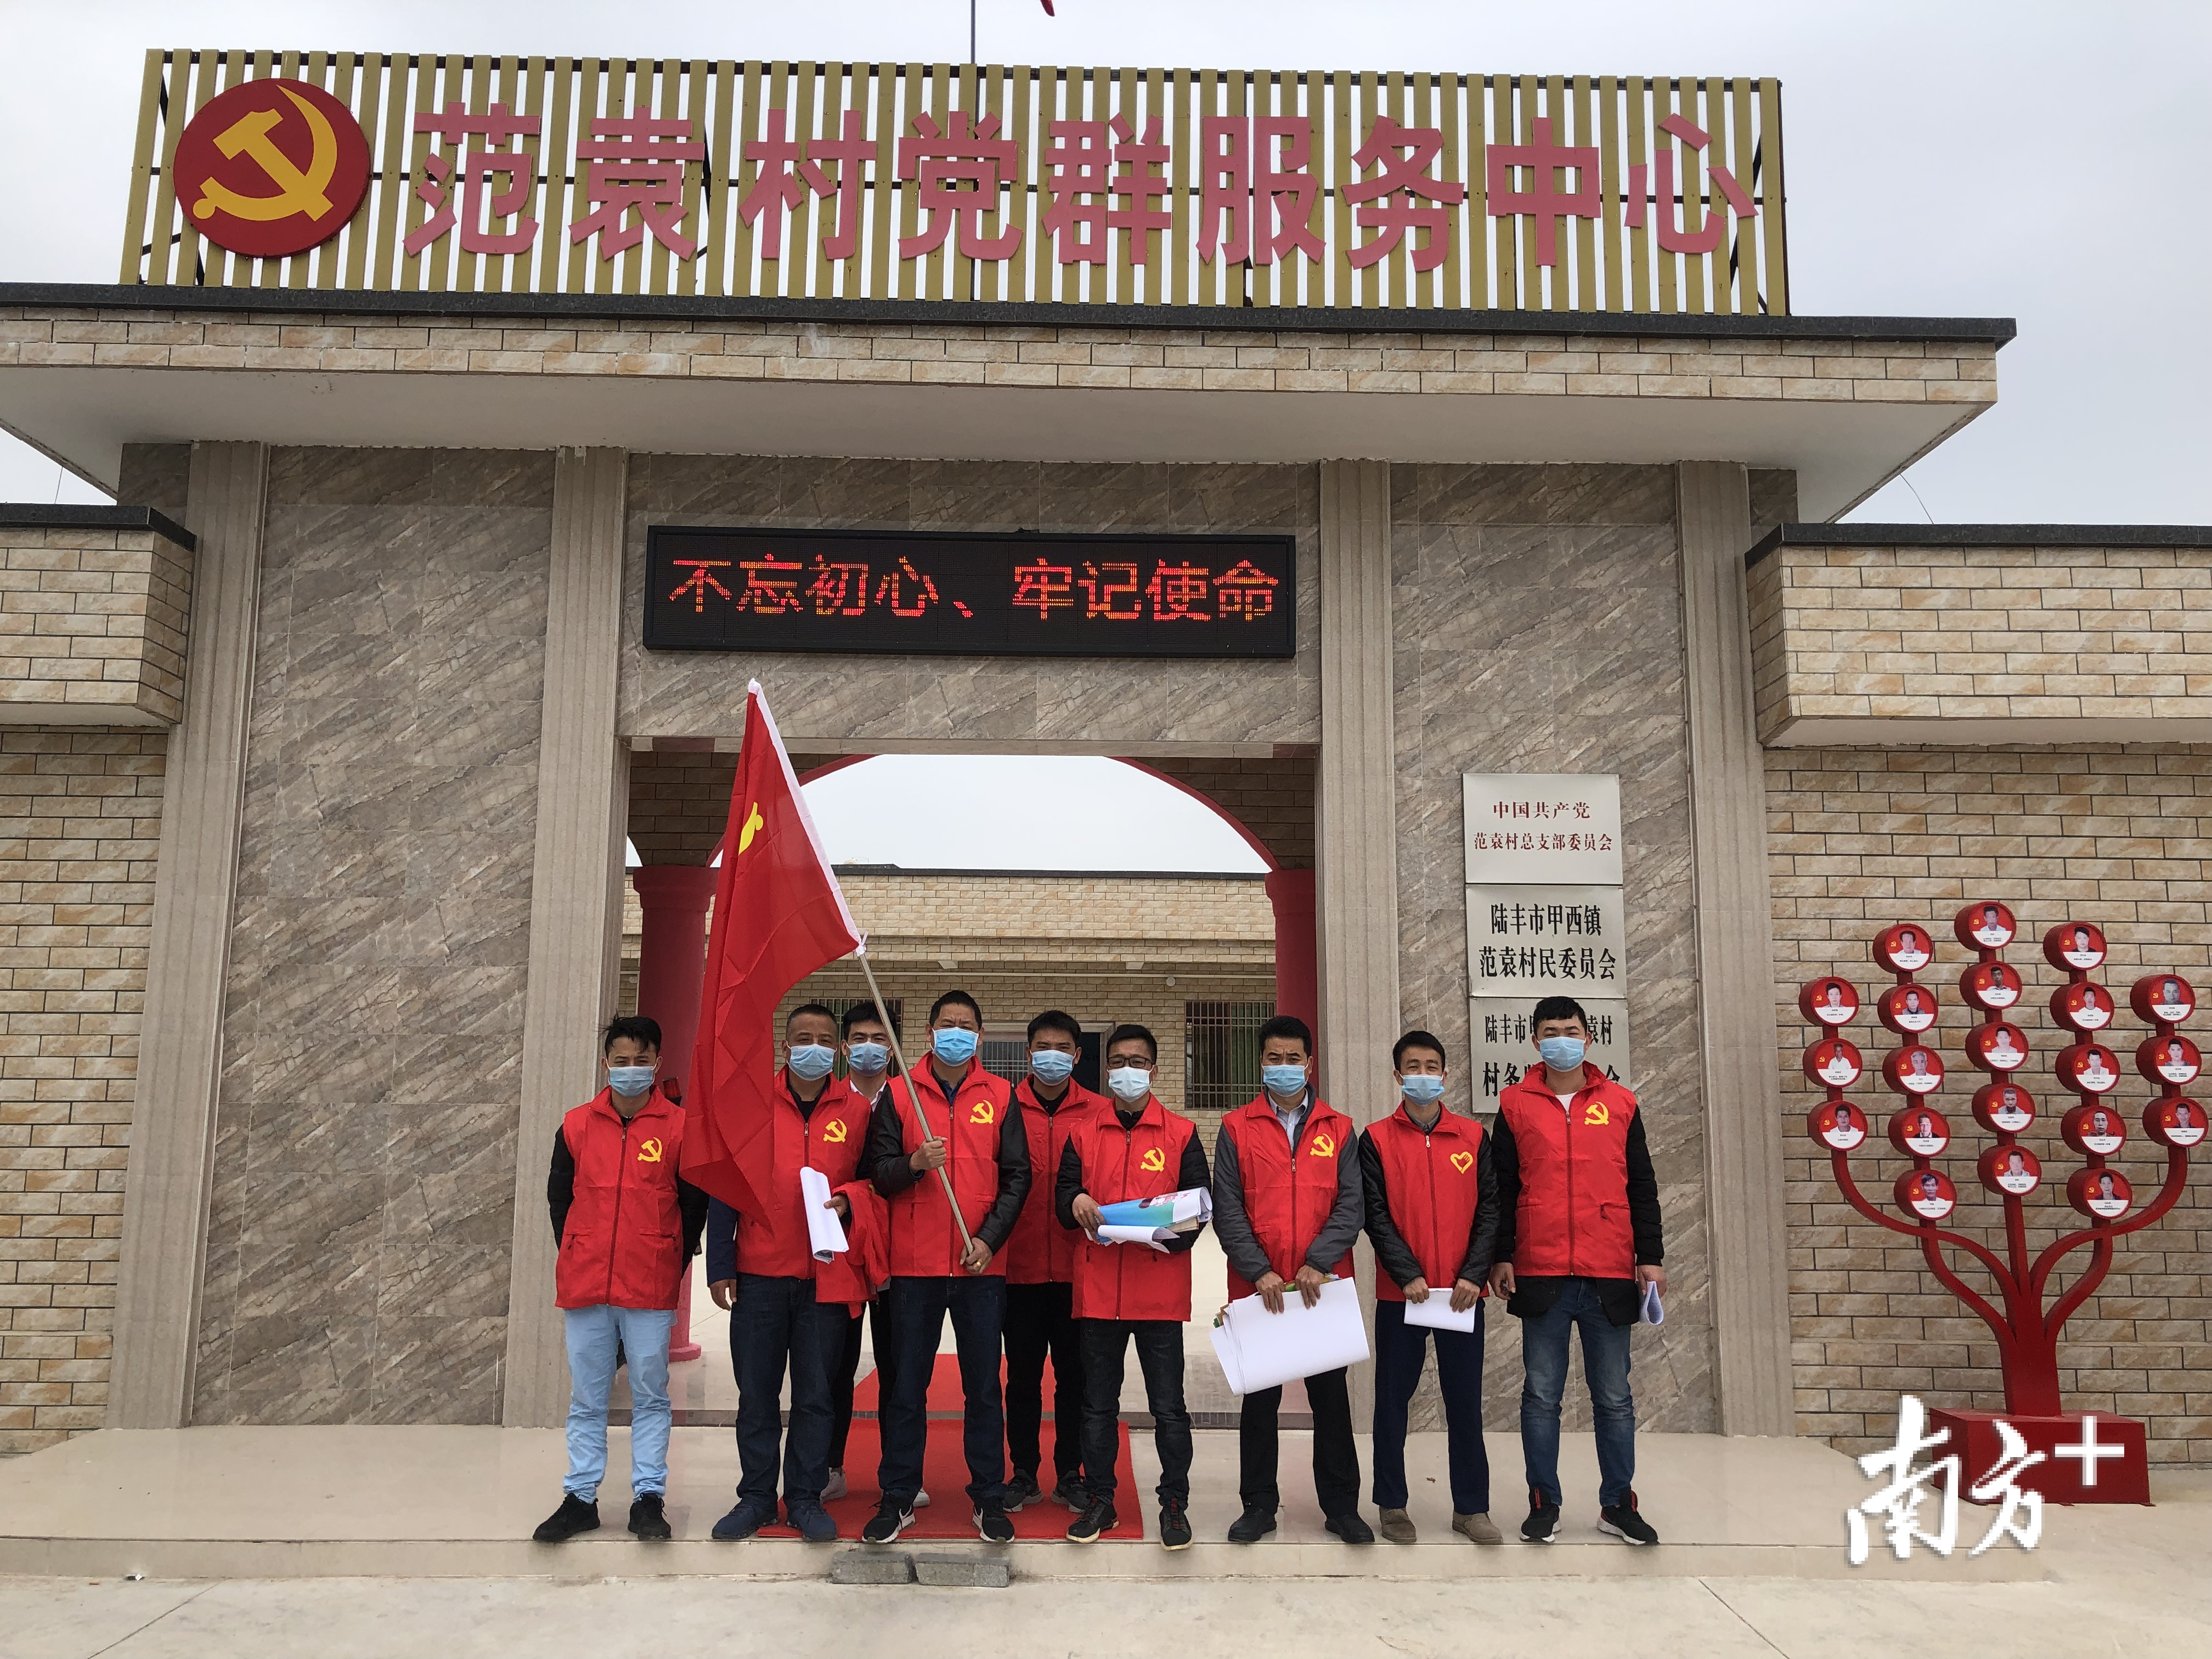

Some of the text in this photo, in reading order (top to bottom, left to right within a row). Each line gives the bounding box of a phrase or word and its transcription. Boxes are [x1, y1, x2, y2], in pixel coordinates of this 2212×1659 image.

[403, 102, 1757, 272] 范袁村党群服务中心
[670, 554, 1278, 622] 不忘初心、牢记使命
[1493, 801, 1590, 819] 中国共产党
[1474, 833, 1613, 851] 范袁村总支部委员会
[1491, 902, 1602, 936] 陆丰市甲西镇
[1479, 946, 1616, 980] 范袁村民委员会
[1485, 1013, 1613, 1045] 陆丰市袁村
